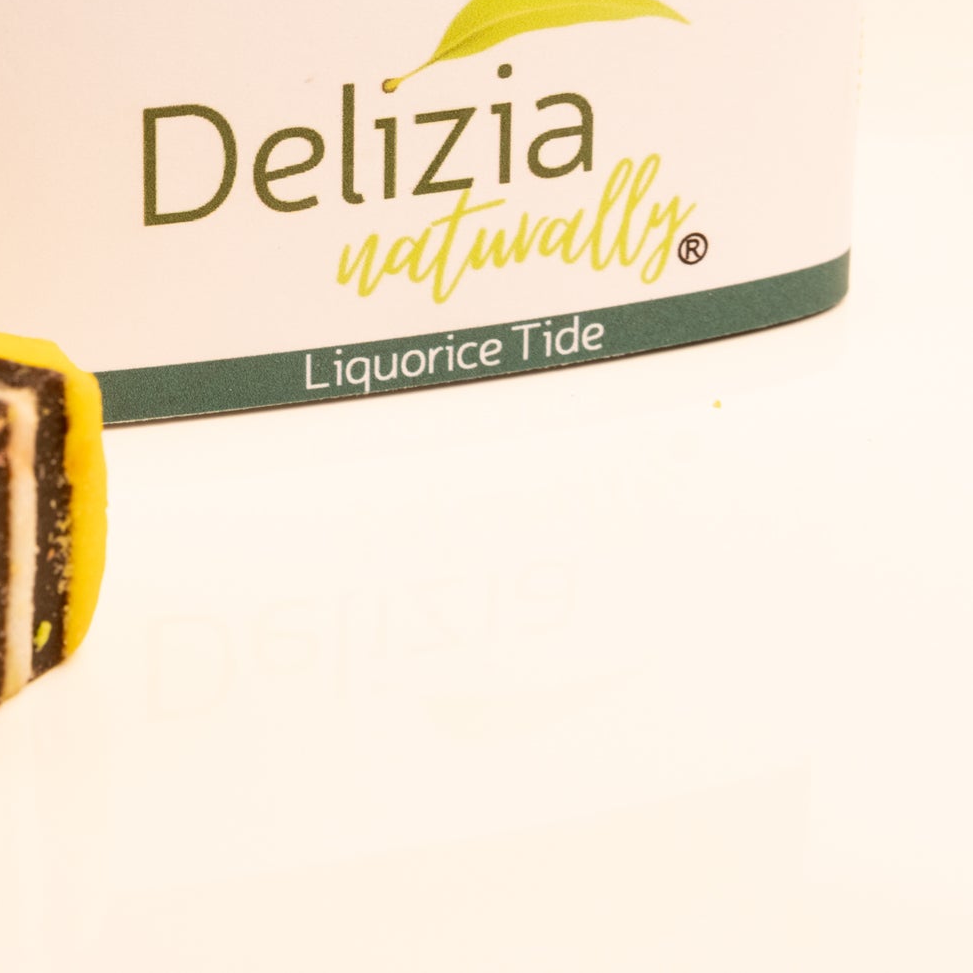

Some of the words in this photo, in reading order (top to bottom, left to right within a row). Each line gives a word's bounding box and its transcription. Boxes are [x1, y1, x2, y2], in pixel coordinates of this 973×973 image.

[143, 64, 594, 227] Delizia
[336, 154, 697, 304] naturally
[305, 337, 503, 393] Liquorice
[512, 316, 605, 362] Tide
